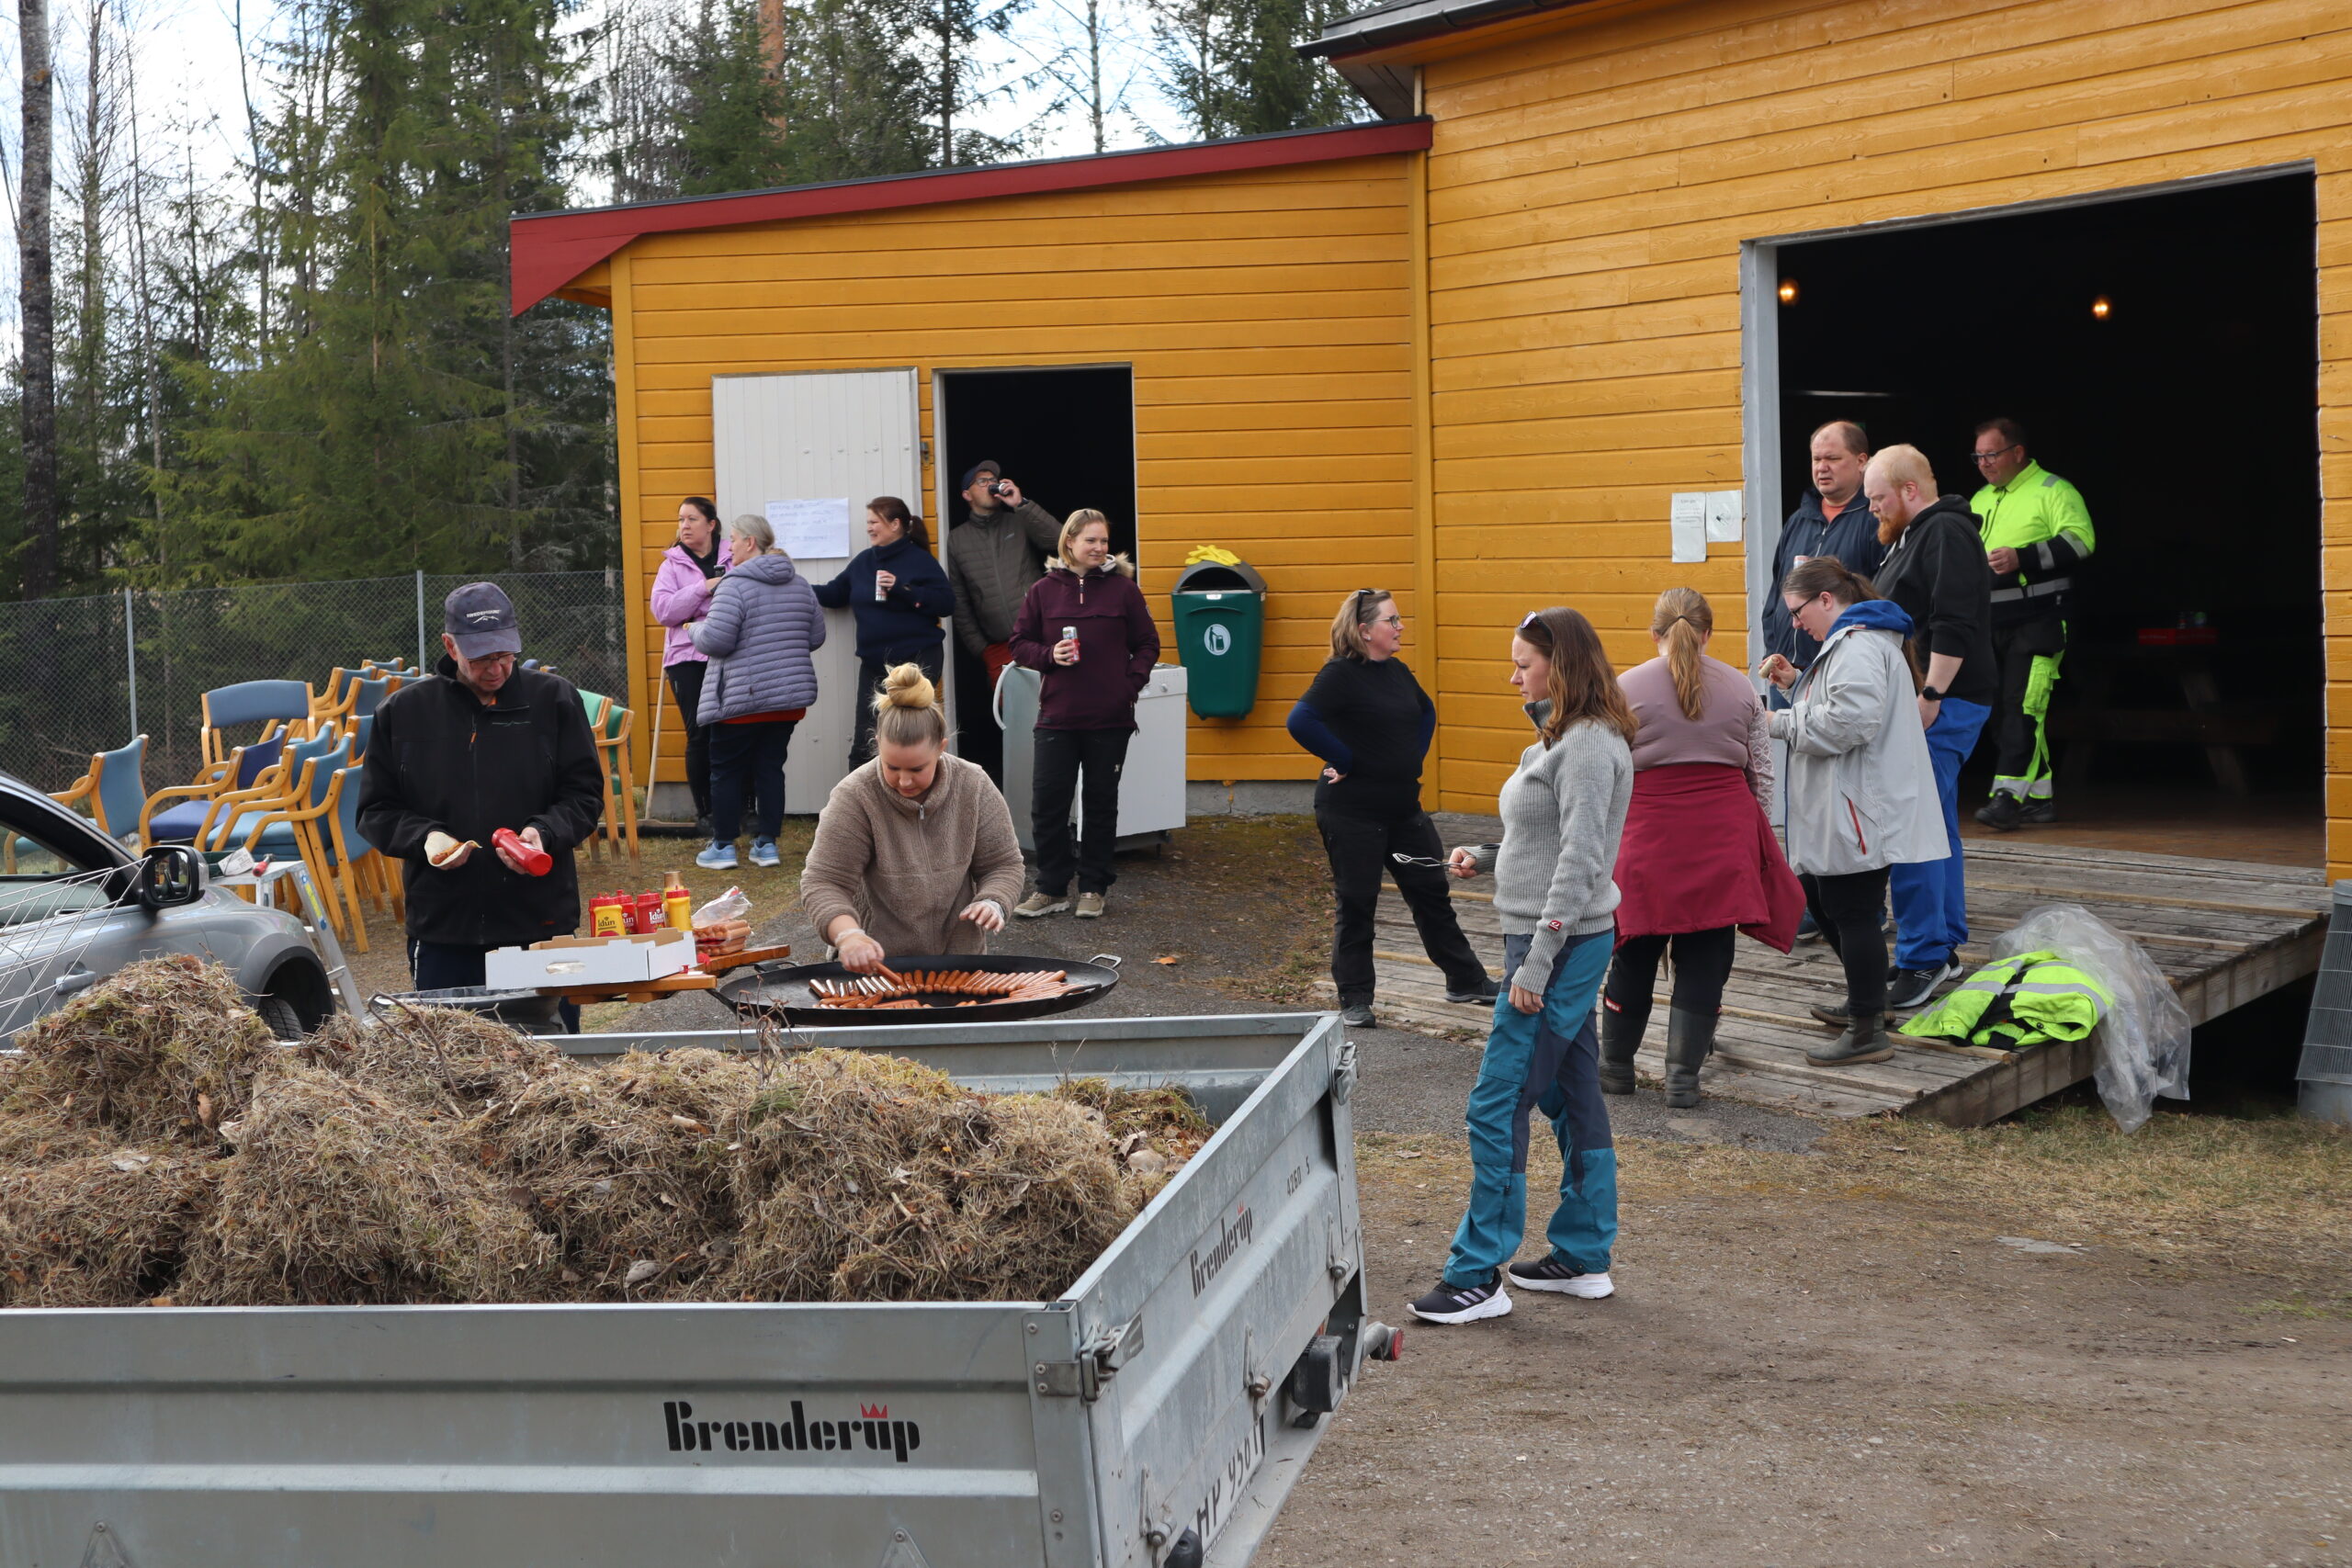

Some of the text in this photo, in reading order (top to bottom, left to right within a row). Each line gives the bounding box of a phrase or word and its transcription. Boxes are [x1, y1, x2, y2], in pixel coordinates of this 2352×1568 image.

[598, 919, 616, 927] Idun
[1190, 1207, 1253, 1300] Brenderup
[663, 1400, 921, 1462] Brenderup
[1196, 1477, 1221, 1545] HP
